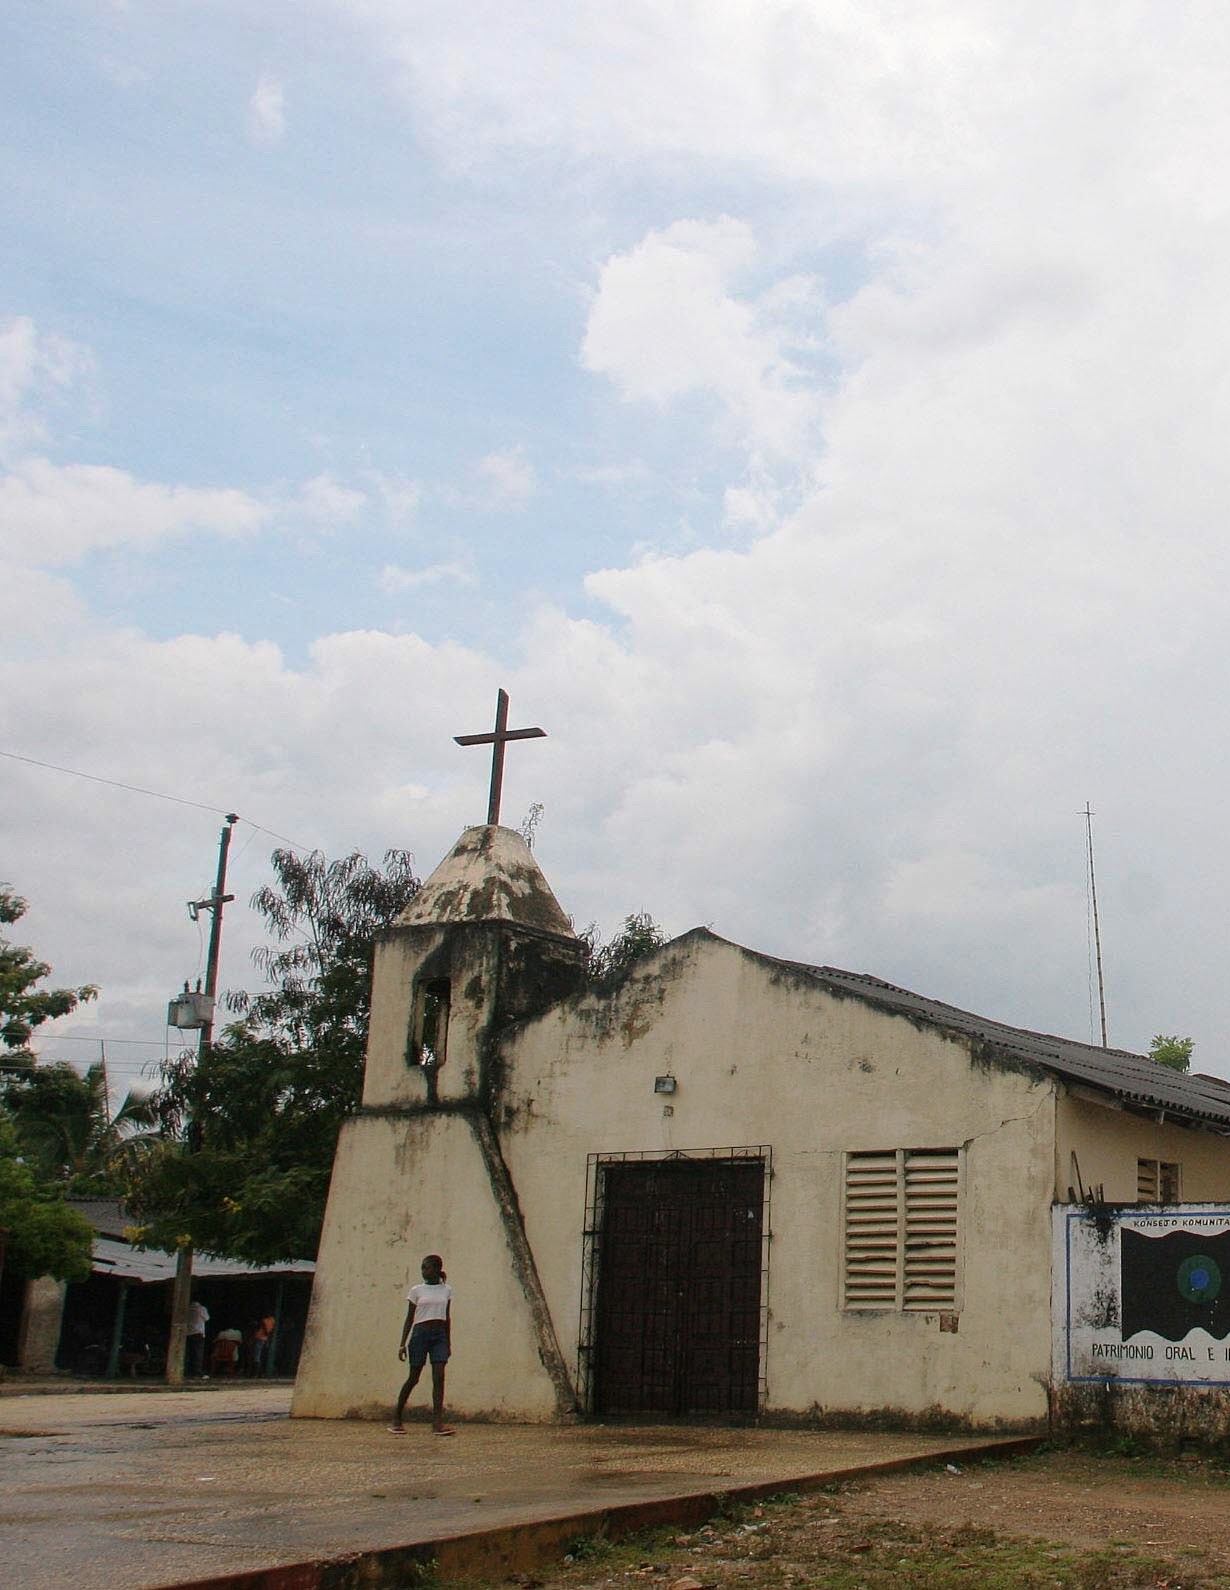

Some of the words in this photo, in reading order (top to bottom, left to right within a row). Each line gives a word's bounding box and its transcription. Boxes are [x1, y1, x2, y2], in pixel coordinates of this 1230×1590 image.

[1133, 1219, 1178, 1227] KONSEJO
[1092, 1343, 1154, 1360] PATRIMONIO
[1165, 1347, 1196, 1361] ORAL
[1208, 1347, 1215, 1361] E
